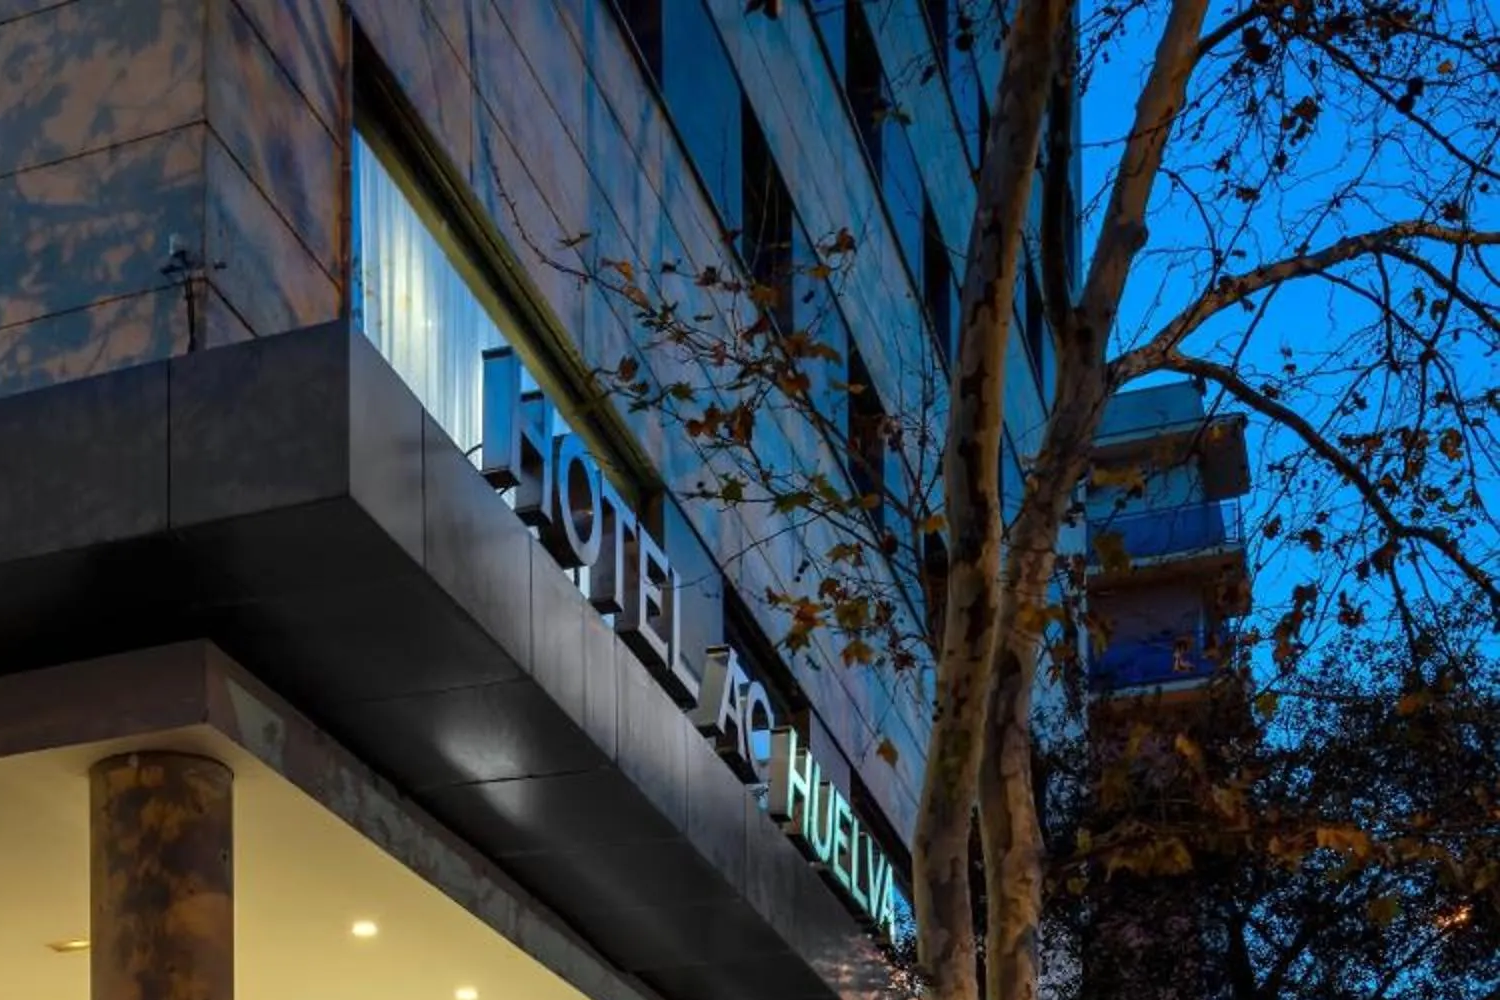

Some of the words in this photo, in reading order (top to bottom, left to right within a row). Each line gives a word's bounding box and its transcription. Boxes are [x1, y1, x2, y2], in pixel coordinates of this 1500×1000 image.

[481, 346, 701, 708] HOTEL
[699, 646, 776, 788] AC
[770, 726, 899, 946] HUELVA
